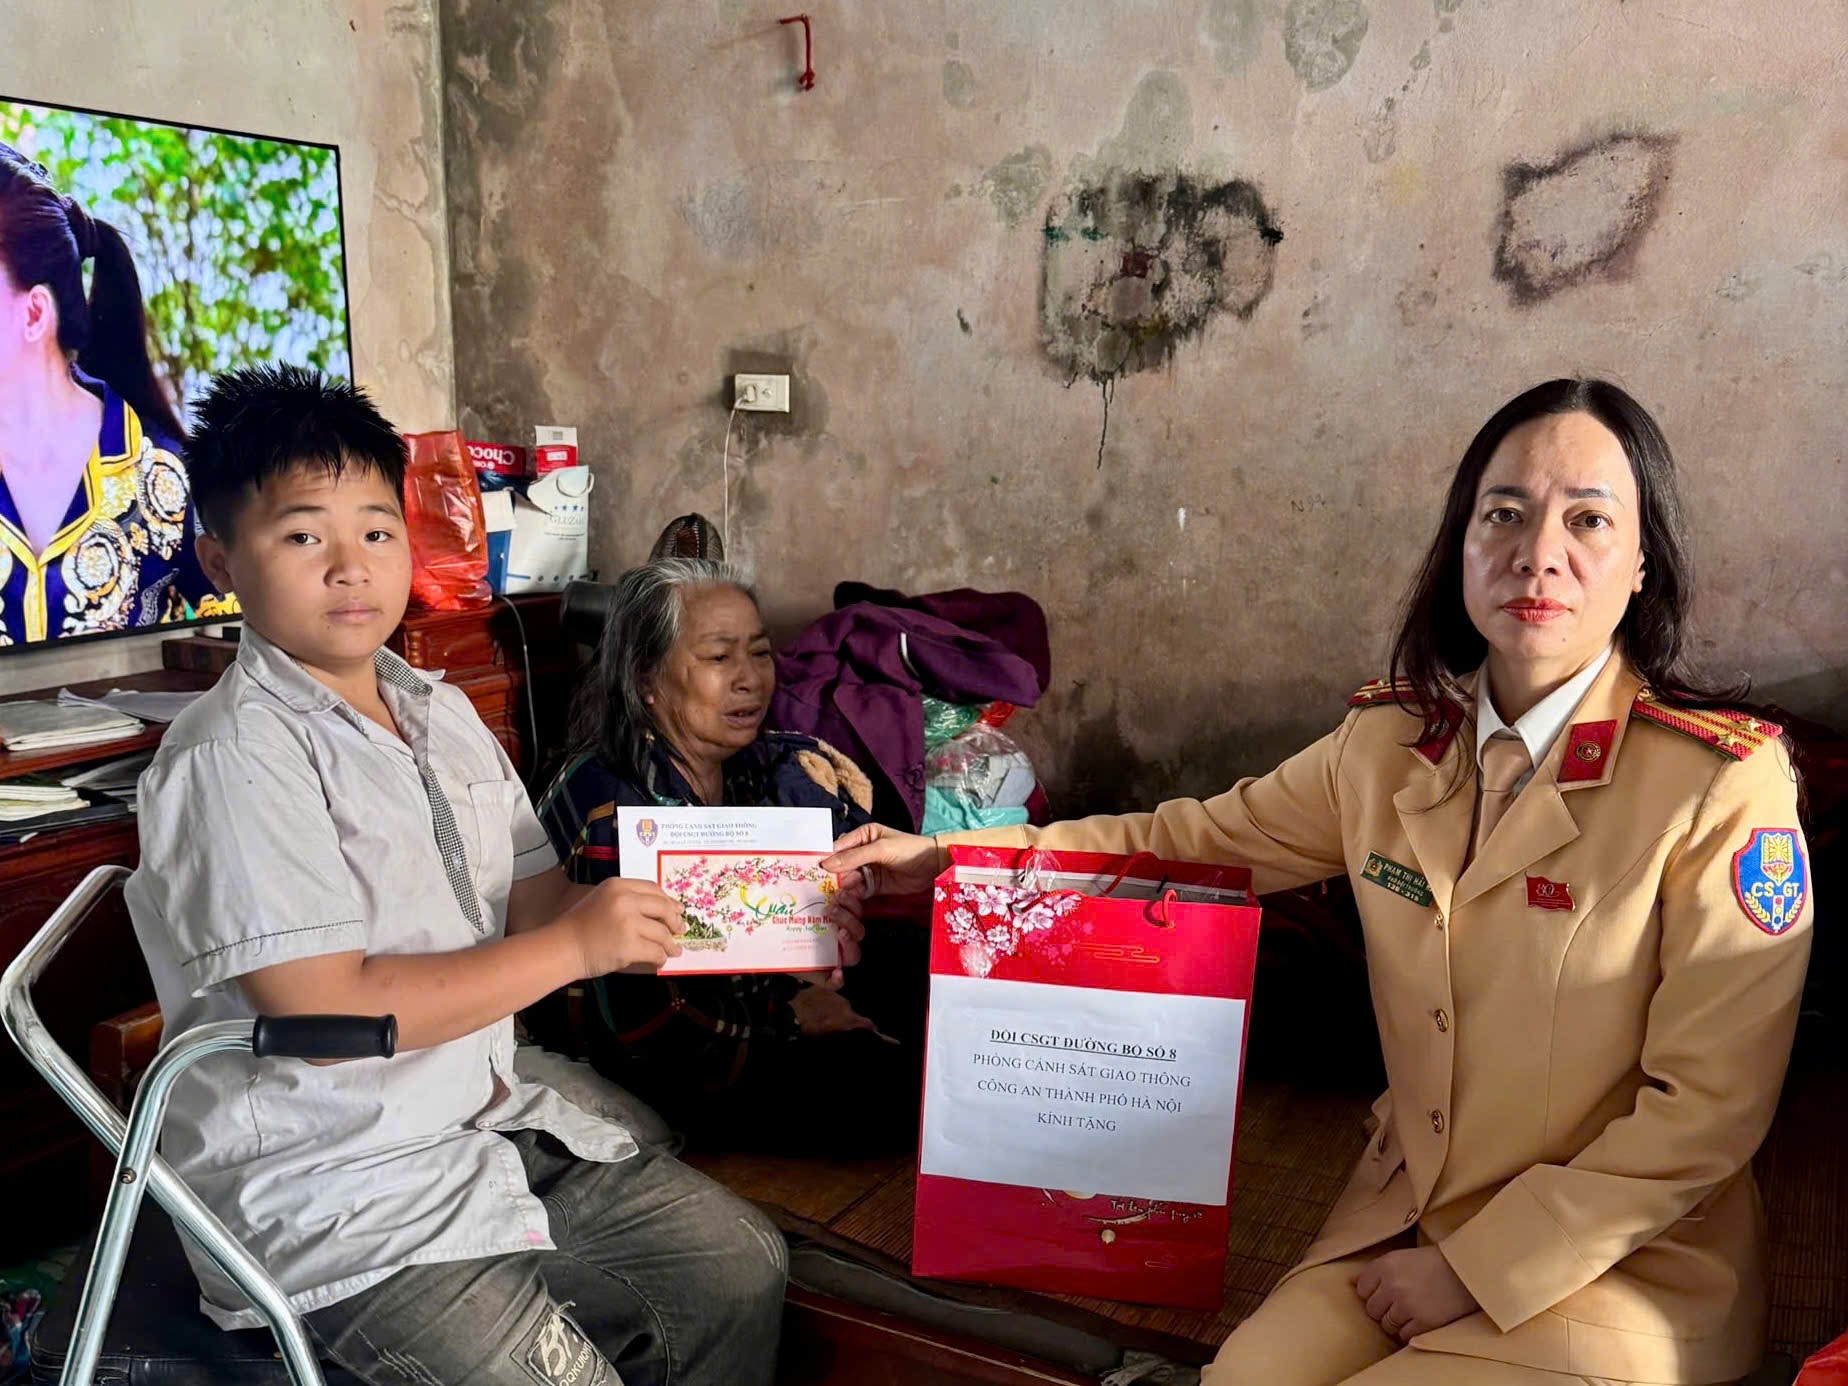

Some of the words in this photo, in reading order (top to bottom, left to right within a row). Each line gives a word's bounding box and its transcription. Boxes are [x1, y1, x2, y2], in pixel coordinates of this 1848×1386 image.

[991, 1029, 1016, 1042] ĐỘI
[1021, 1033, 1060, 1047] CSGT
[1064, 1037, 1118, 1054] ĐƯỜNG
[1122, 1043, 1142, 1057] BỘ
[1146, 1045, 1166, 1059] SỐ
[1169, 1048, 1177, 1060] 8
[973, 1052, 1021, 1069] PHÒNG
[1025, 1056, 1065, 1074] CẢNH
[1069, 1062, 1097, 1077] SÁT
[1100, 1067, 1136, 1082] GIAO
[1140, 1072, 1191, 1087] THÔNG
[977, 1078, 1017, 1095] CÔNG
[1021, 1085, 1041, 1097] AN
[1045, 1087, 1095, 1104] THÀNH
[1099, 1092, 1128, 1107] PHỐ
[1131, 1096, 1151, 1110] HÀ
[1156, 1098, 1181, 1114] NỘI
[1037, 1111, 1073, 1127] KÍNH
[1076, 1116, 1116, 1132] TẶNG
